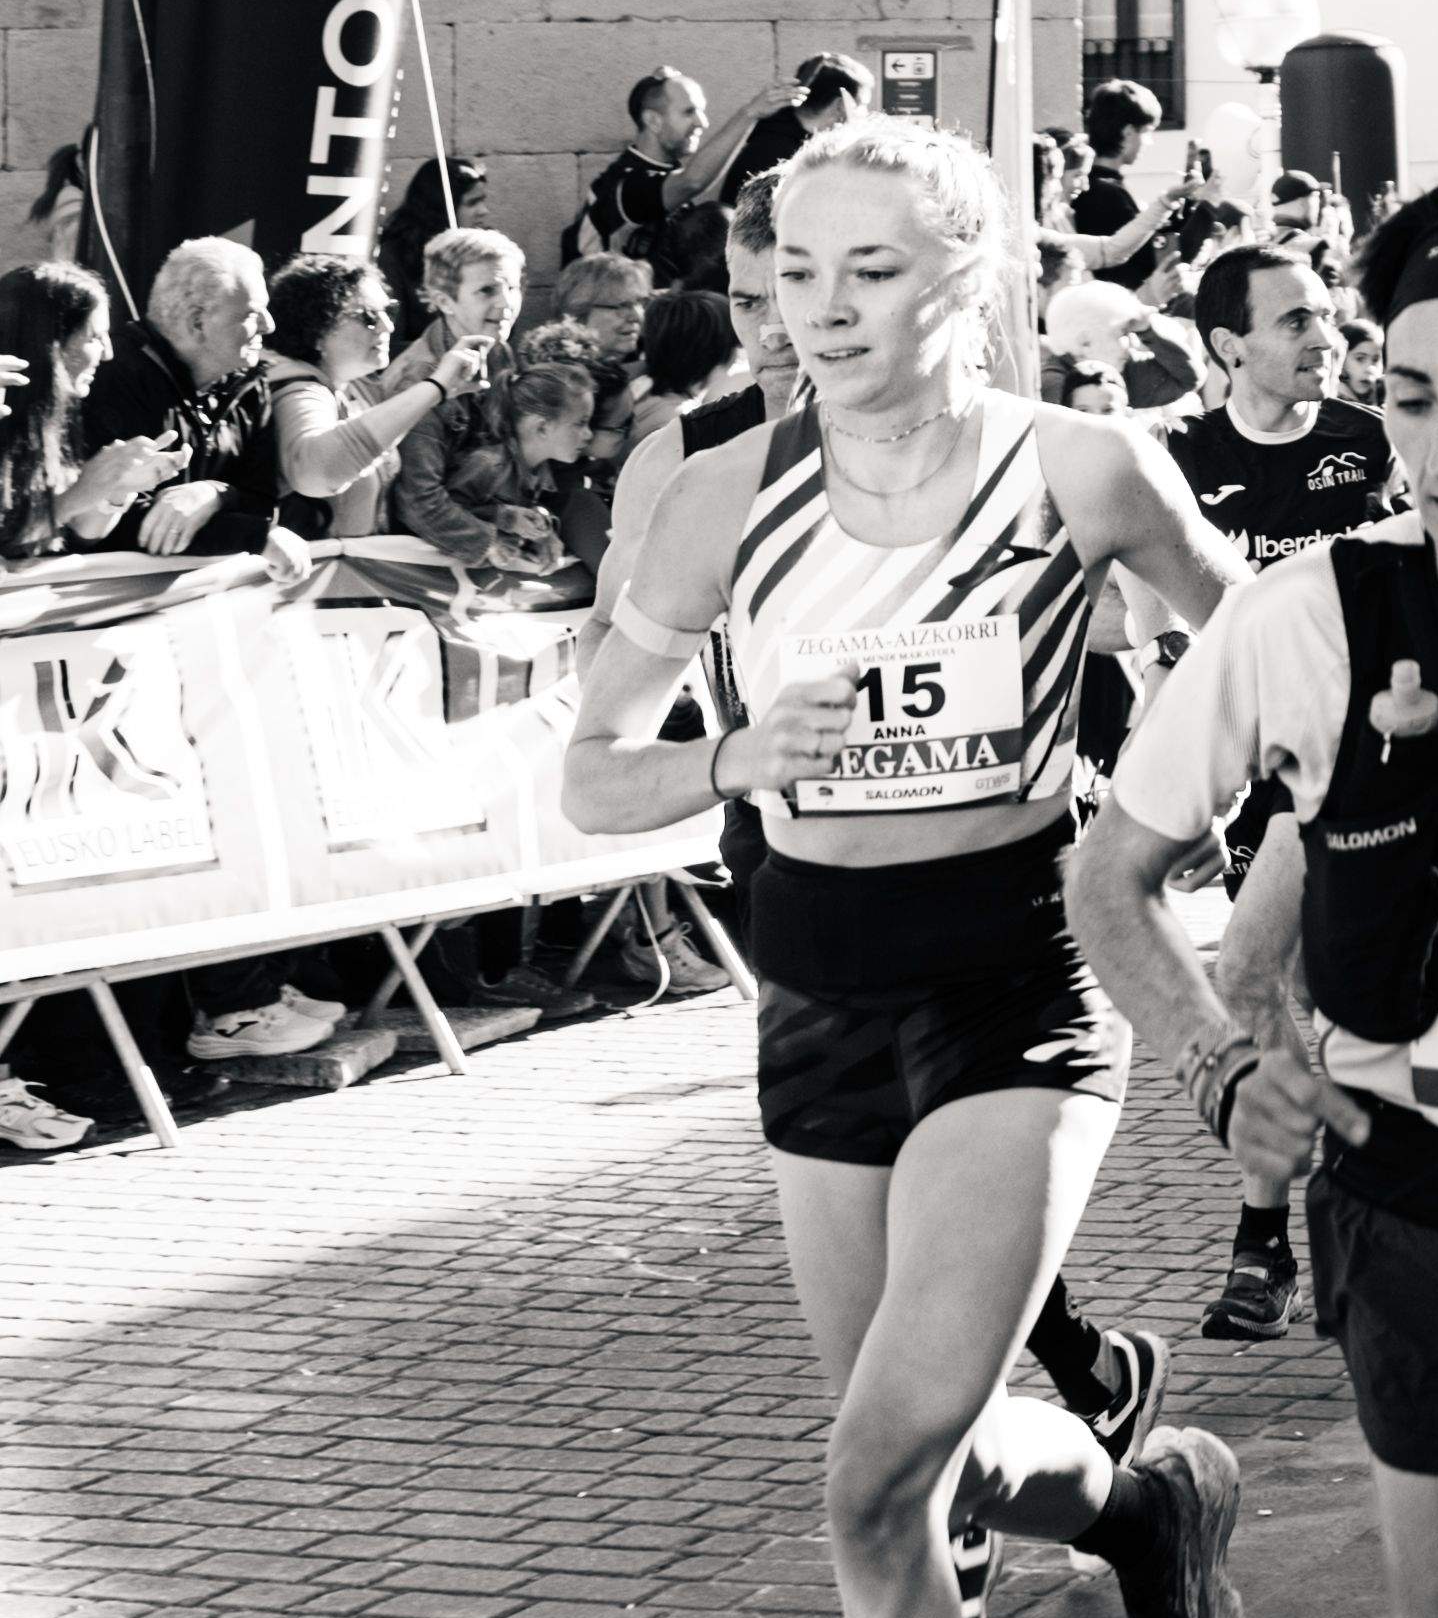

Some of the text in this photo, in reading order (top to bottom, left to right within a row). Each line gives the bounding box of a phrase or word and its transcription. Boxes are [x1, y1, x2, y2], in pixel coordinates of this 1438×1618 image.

[1307, 468, 1368, 492] OSIN TRAIL
[856, 661, 947, 723] 15
[874, 724, 927, 741] ANNA
[824, 734, 1001, 780] EGAMA
[865, 785, 944, 801] SALOMON
[16, 817, 205, 867] EUSKO LABEL
